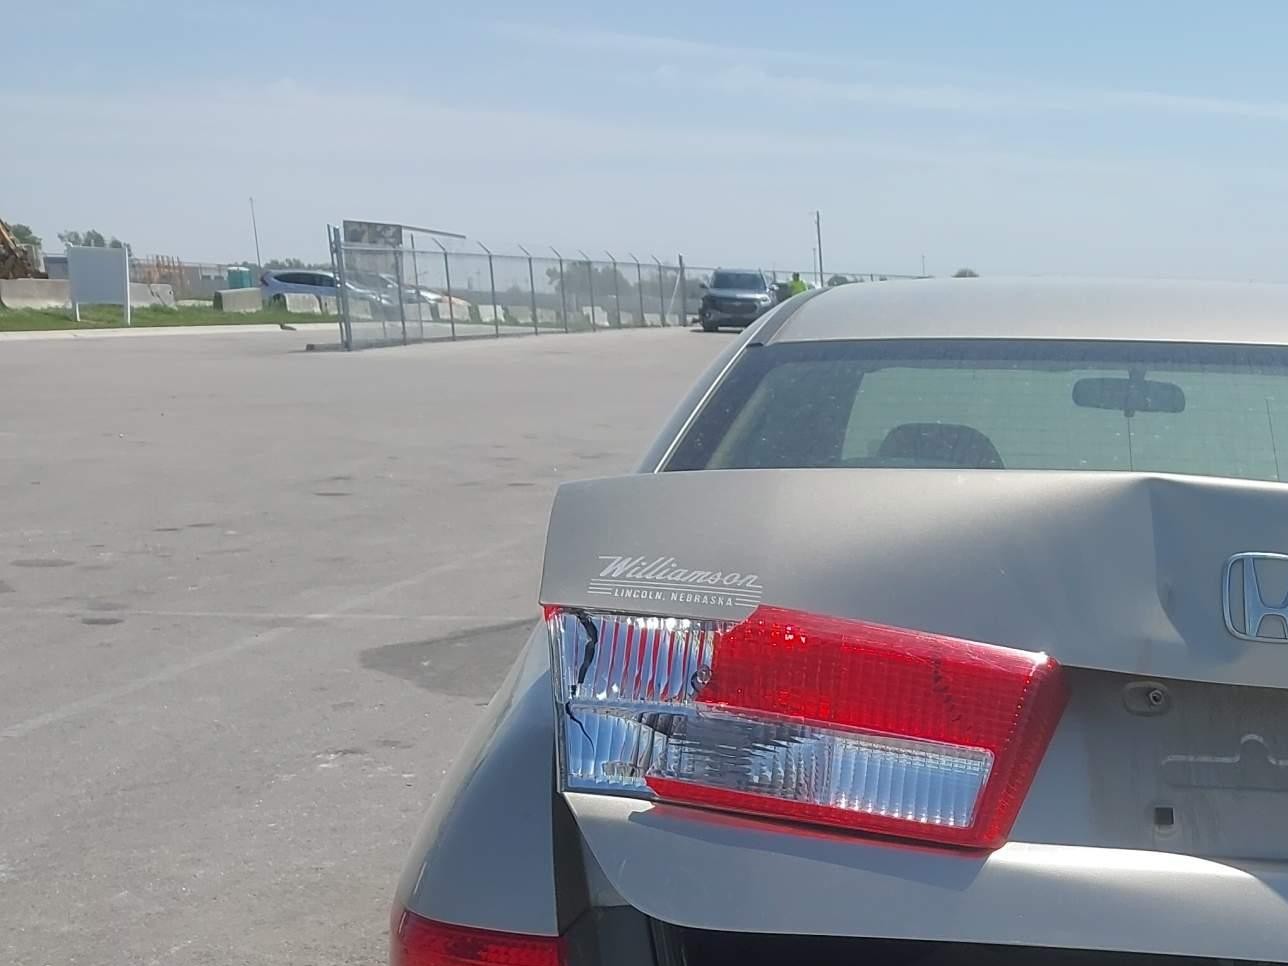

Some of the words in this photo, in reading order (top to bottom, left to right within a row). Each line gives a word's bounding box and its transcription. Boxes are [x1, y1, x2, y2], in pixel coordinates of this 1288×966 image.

[598, 555, 763, 589] Williamson
[614, 588, 666, 601] LINCOLN,
[671, 592, 733, 607] NEBRASKA
